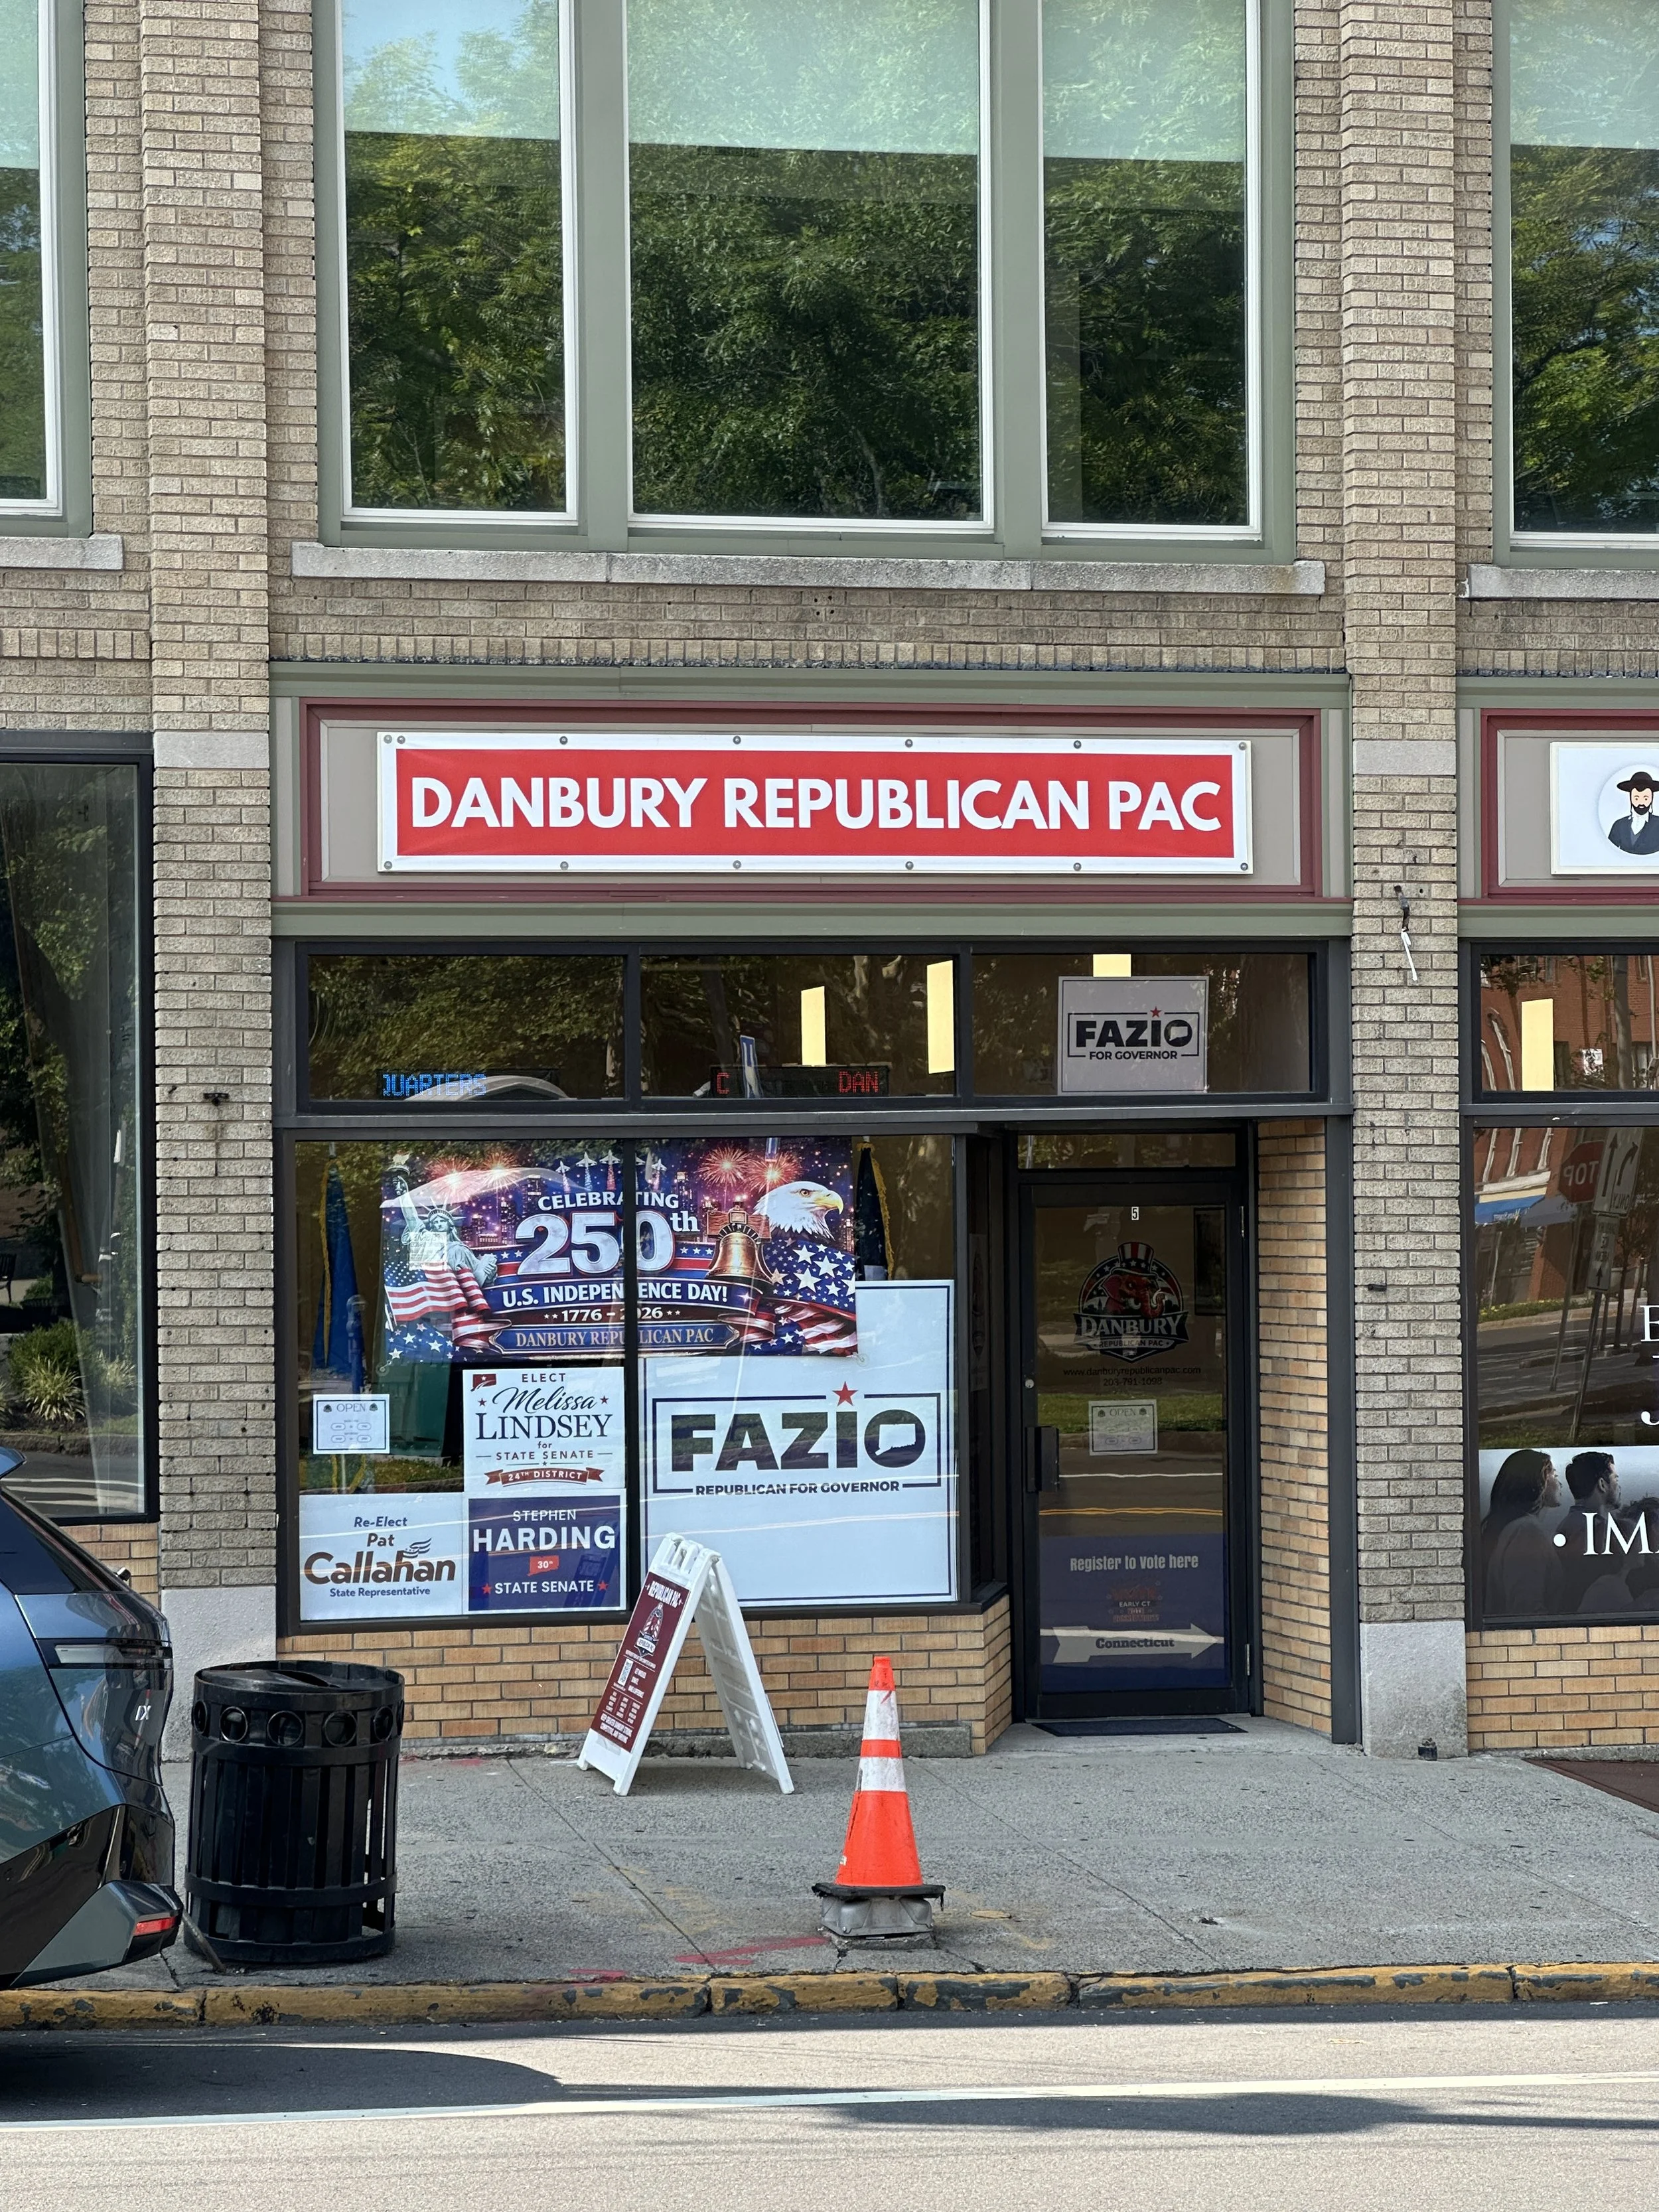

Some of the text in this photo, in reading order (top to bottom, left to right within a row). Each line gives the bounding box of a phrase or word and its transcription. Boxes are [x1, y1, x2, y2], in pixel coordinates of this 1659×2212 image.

[412, 777, 1222, 831] DANBURY REPUBLICAN PAC
[1076, 1019, 1193, 1047] FAZIO
[1090, 1051, 1178, 1060] FOR GOVERNOR
[839, 1070, 879, 1093] DAN
[1132, 1207, 1137, 1219] 5
[515, 1210, 700, 1275] 250th
[502, 1282, 728, 1307] U.S. INDEPENENCE DAY!
[561, 1309, 602, 1321] 1776
[1080, 1315, 1182, 1337] DANBURY
[516, 1328, 714, 1347] DANBURY REPULICAN PAC
[522, 1373, 566, 1382] ELECT
[336, 1403, 366, 1412] OPEN
[492, 1386, 597, 1414] Melissa
[475, 1413, 613, 1440] LINDSEY
[672, 1409, 926, 1472] FAZIO
[496, 1450, 593, 1461] STATE SENATE
[508, 1470, 582, 1481] 24TH DISTRICT
[696, 1481, 899, 1496] REPUBLICAN FOR GOVERNOR
[354, 1516, 407, 1527] Re-Elect
[513, 1509, 576, 1522] STEPHEN
[367, 1533, 395, 1547] Pat
[473, 1526, 615, 1552] HARDING
[1582, 1511, 1659, 1555] IM
[304, 1550, 456, 1585] Callahan
[1070, 1554, 1198, 1572] Register to vote here
[330, 1586, 431, 1598] State Representative
[495, 1580, 594, 1594] STATE SENATE
[1096, 1637, 1175, 1649] Connecticut
